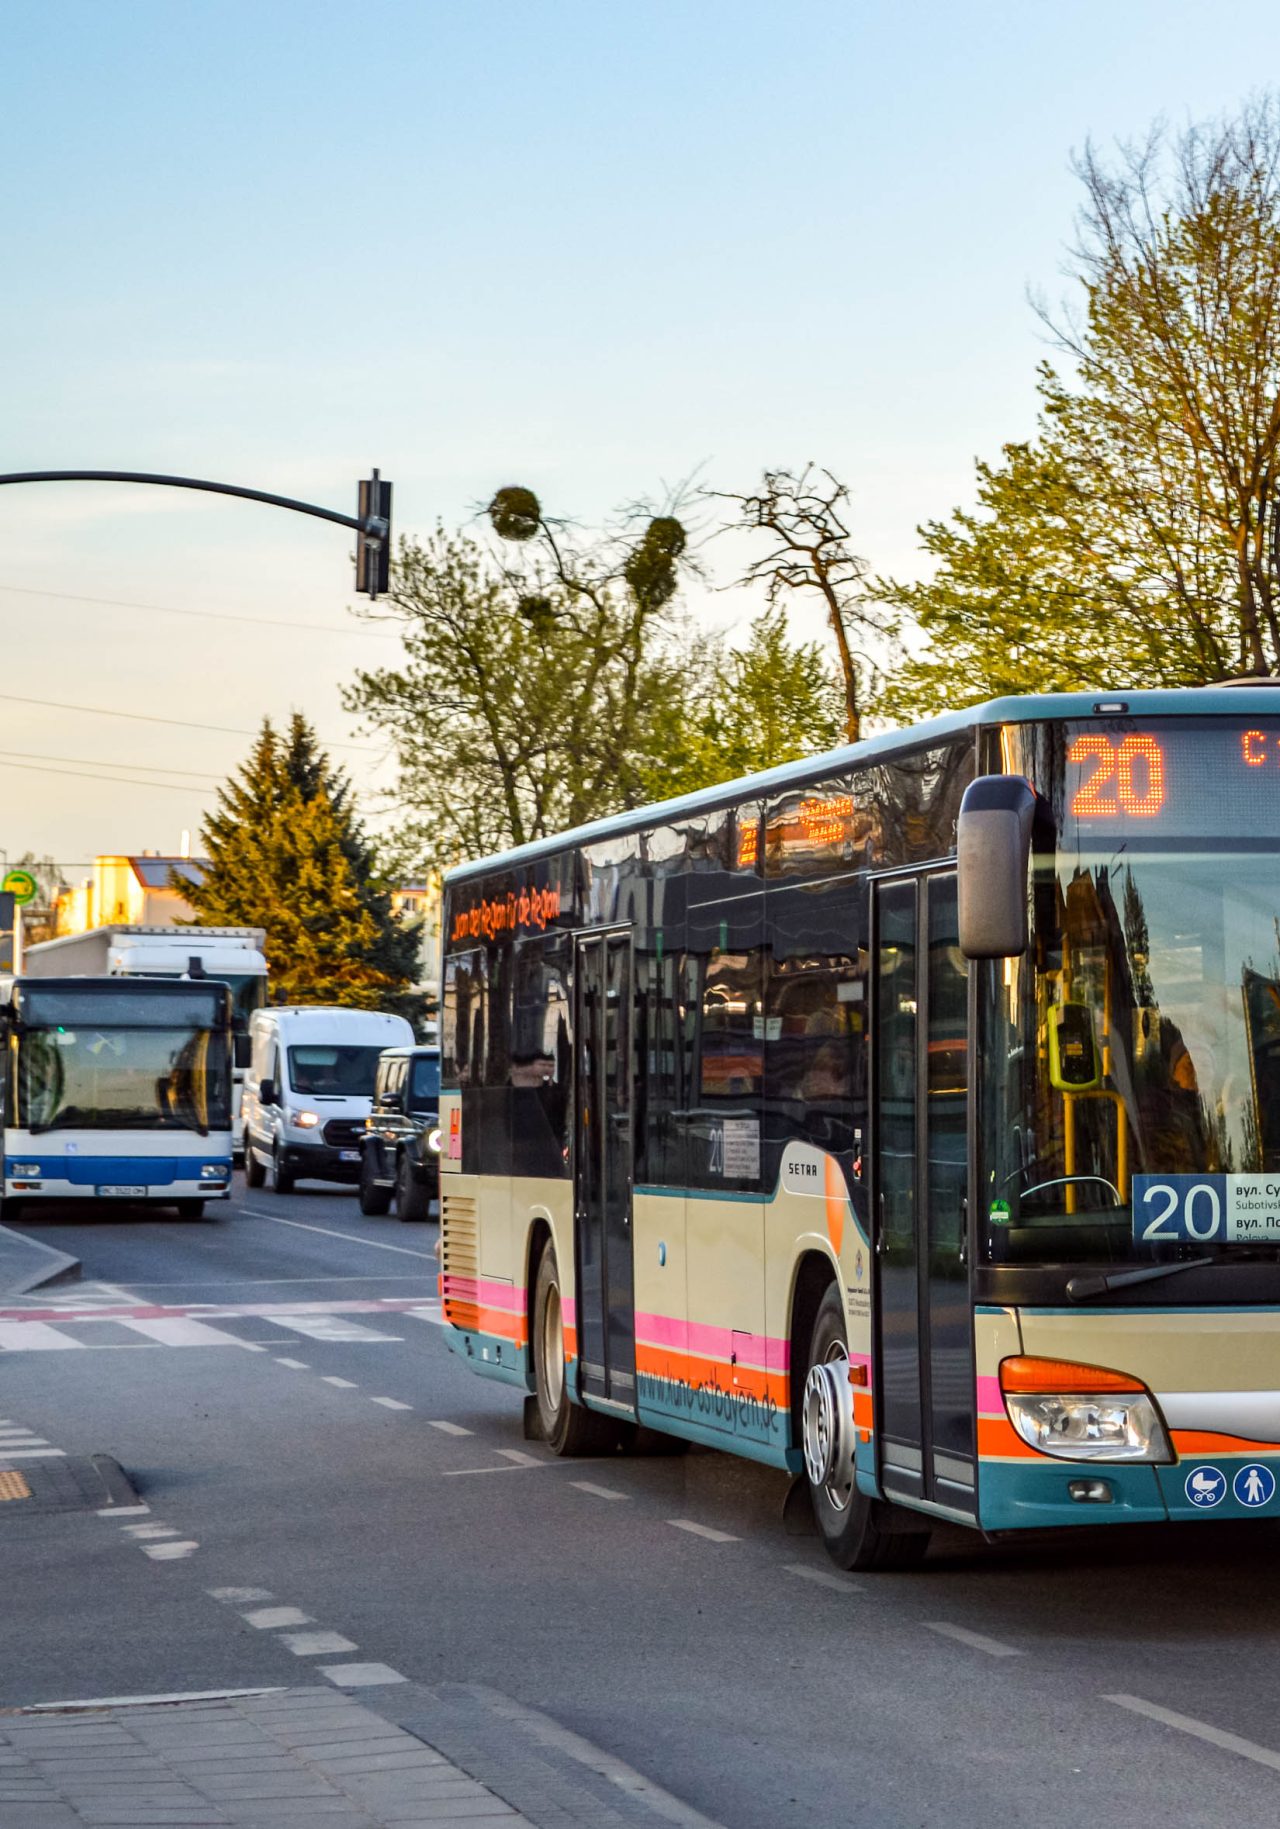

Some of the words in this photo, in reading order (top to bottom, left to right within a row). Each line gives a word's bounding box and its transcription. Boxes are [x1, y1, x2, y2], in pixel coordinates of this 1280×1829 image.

[1070, 736, 1163, 815] 20
[788, 1162, 818, 1177] SETRA
[1236, 1187, 1262, 1198] вул.
[1142, 1184, 1221, 1240] 20
[1236, 1219, 1262, 1230] вул.
